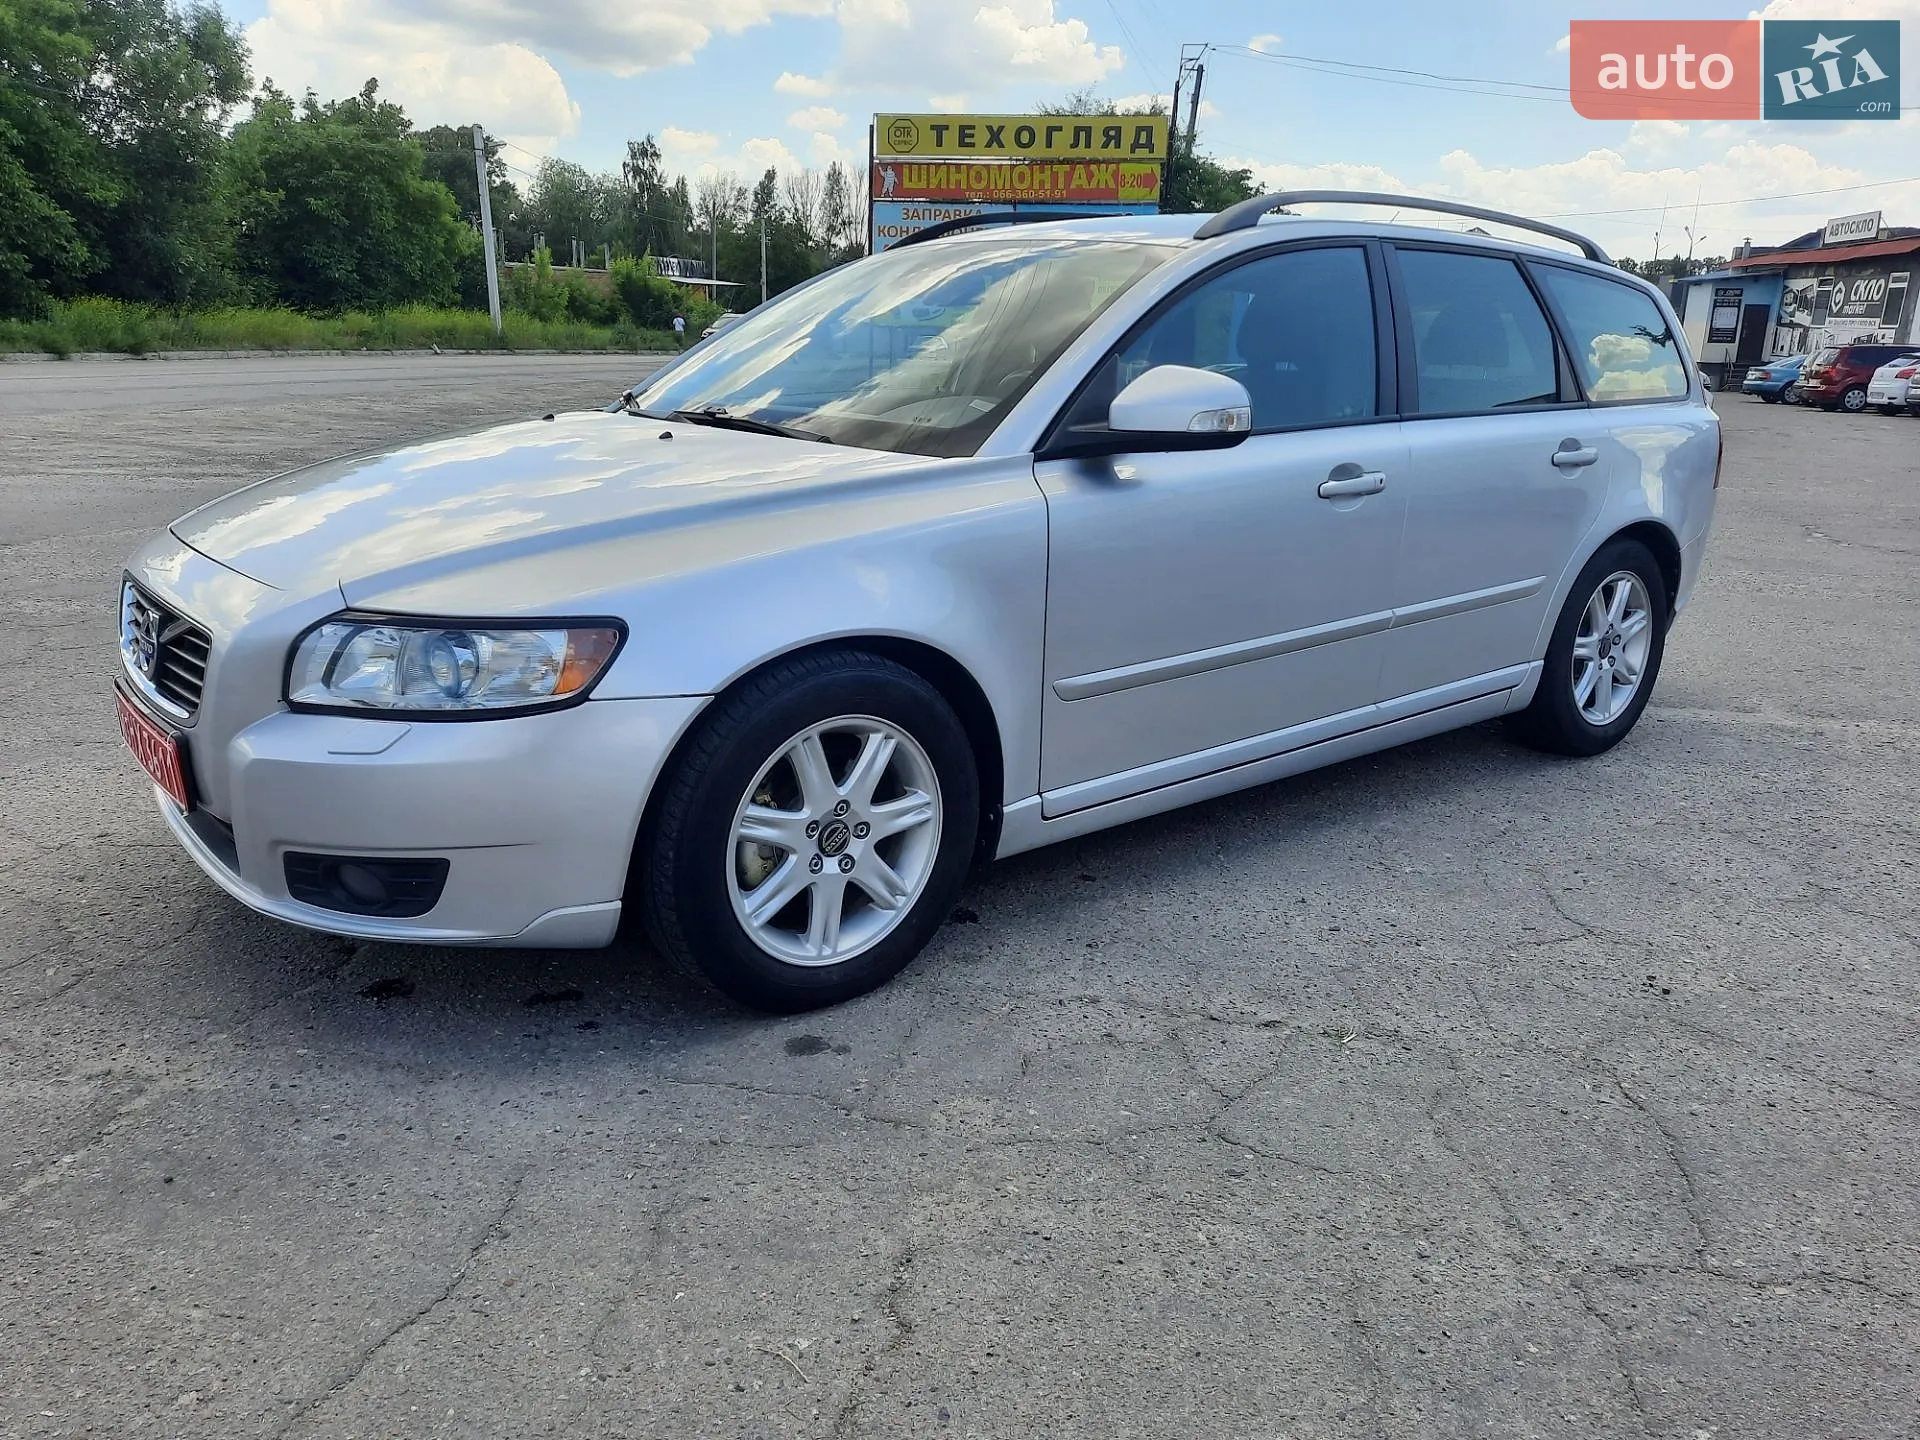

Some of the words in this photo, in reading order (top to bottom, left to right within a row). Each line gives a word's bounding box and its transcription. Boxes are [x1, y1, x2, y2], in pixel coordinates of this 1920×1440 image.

[930, 125, 1155, 154] ТЕХОГЛЯД
[902, 163, 1117, 190] ШИНОМОНТАЖ
[1828, 217, 1875, 238] АВТОСКЛО
[1850, 279, 1886, 302] СКЛО
[825, 828, 848, 852] VOLVO
